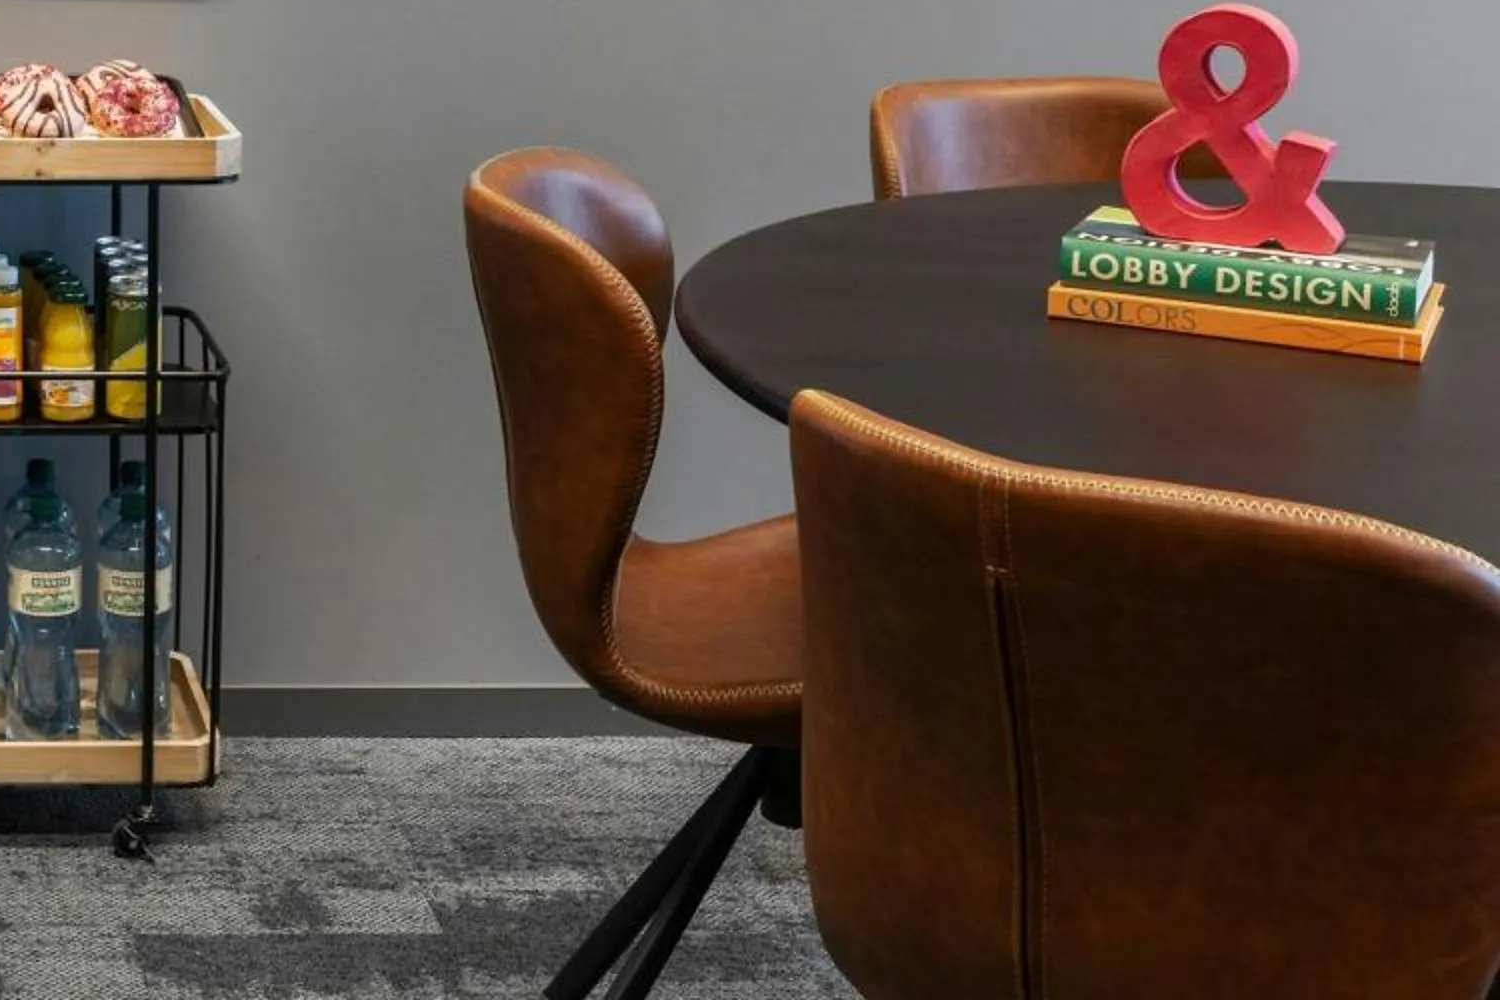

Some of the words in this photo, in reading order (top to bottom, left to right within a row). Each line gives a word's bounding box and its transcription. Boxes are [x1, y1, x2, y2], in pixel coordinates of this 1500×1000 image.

[1070, 250, 1198, 289] LOBBY
[1215, 266, 1372, 312] DESIGN
[1067, 295, 1197, 331] COLORS
